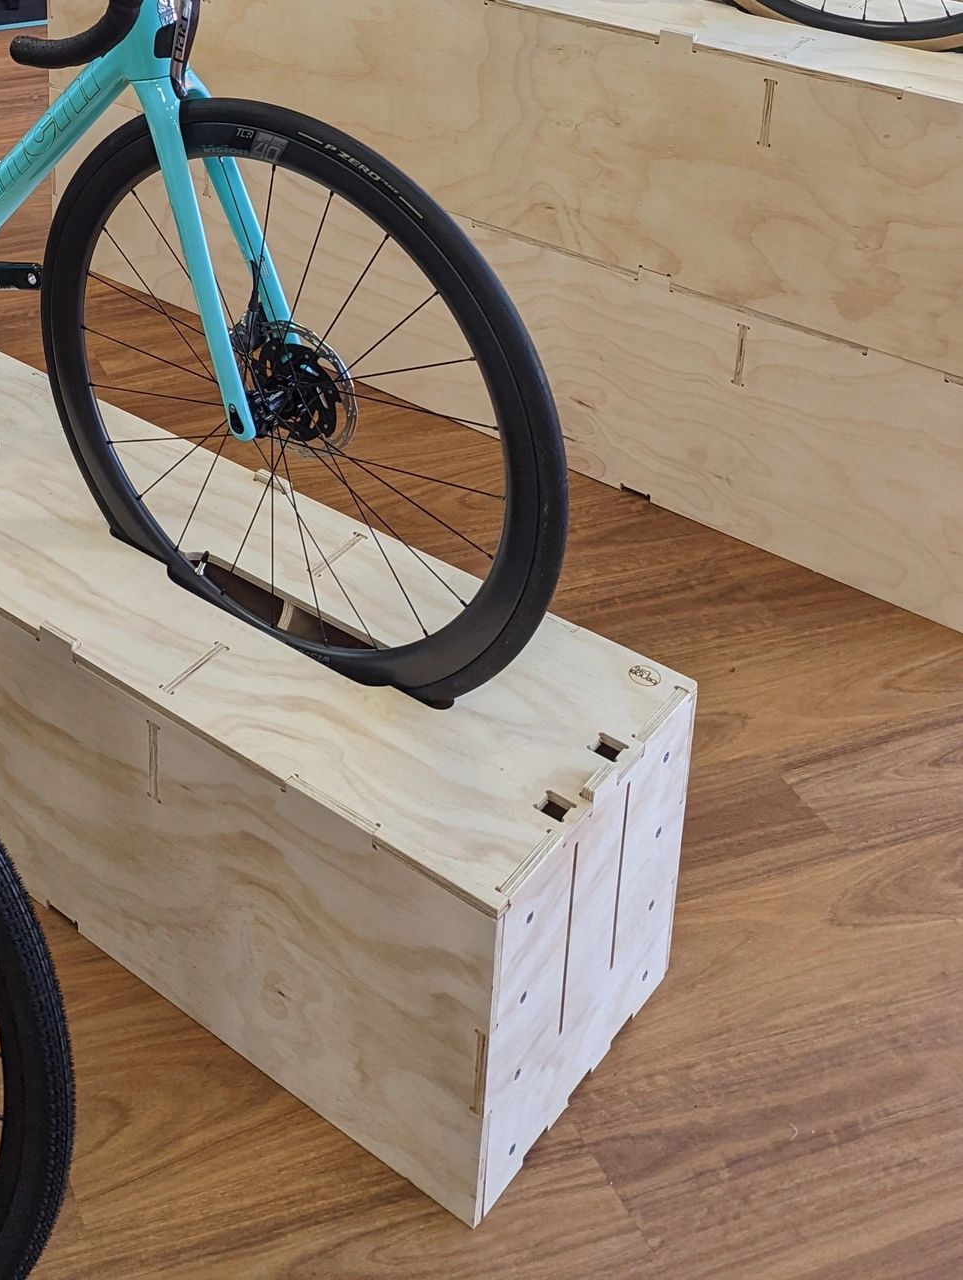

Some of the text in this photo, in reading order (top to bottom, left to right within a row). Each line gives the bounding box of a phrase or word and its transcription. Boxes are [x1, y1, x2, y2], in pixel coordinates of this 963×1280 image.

[201, 144, 249, 156] vision
[324, 143, 337, 152] P
[337, 149, 382, 182] ZERO
